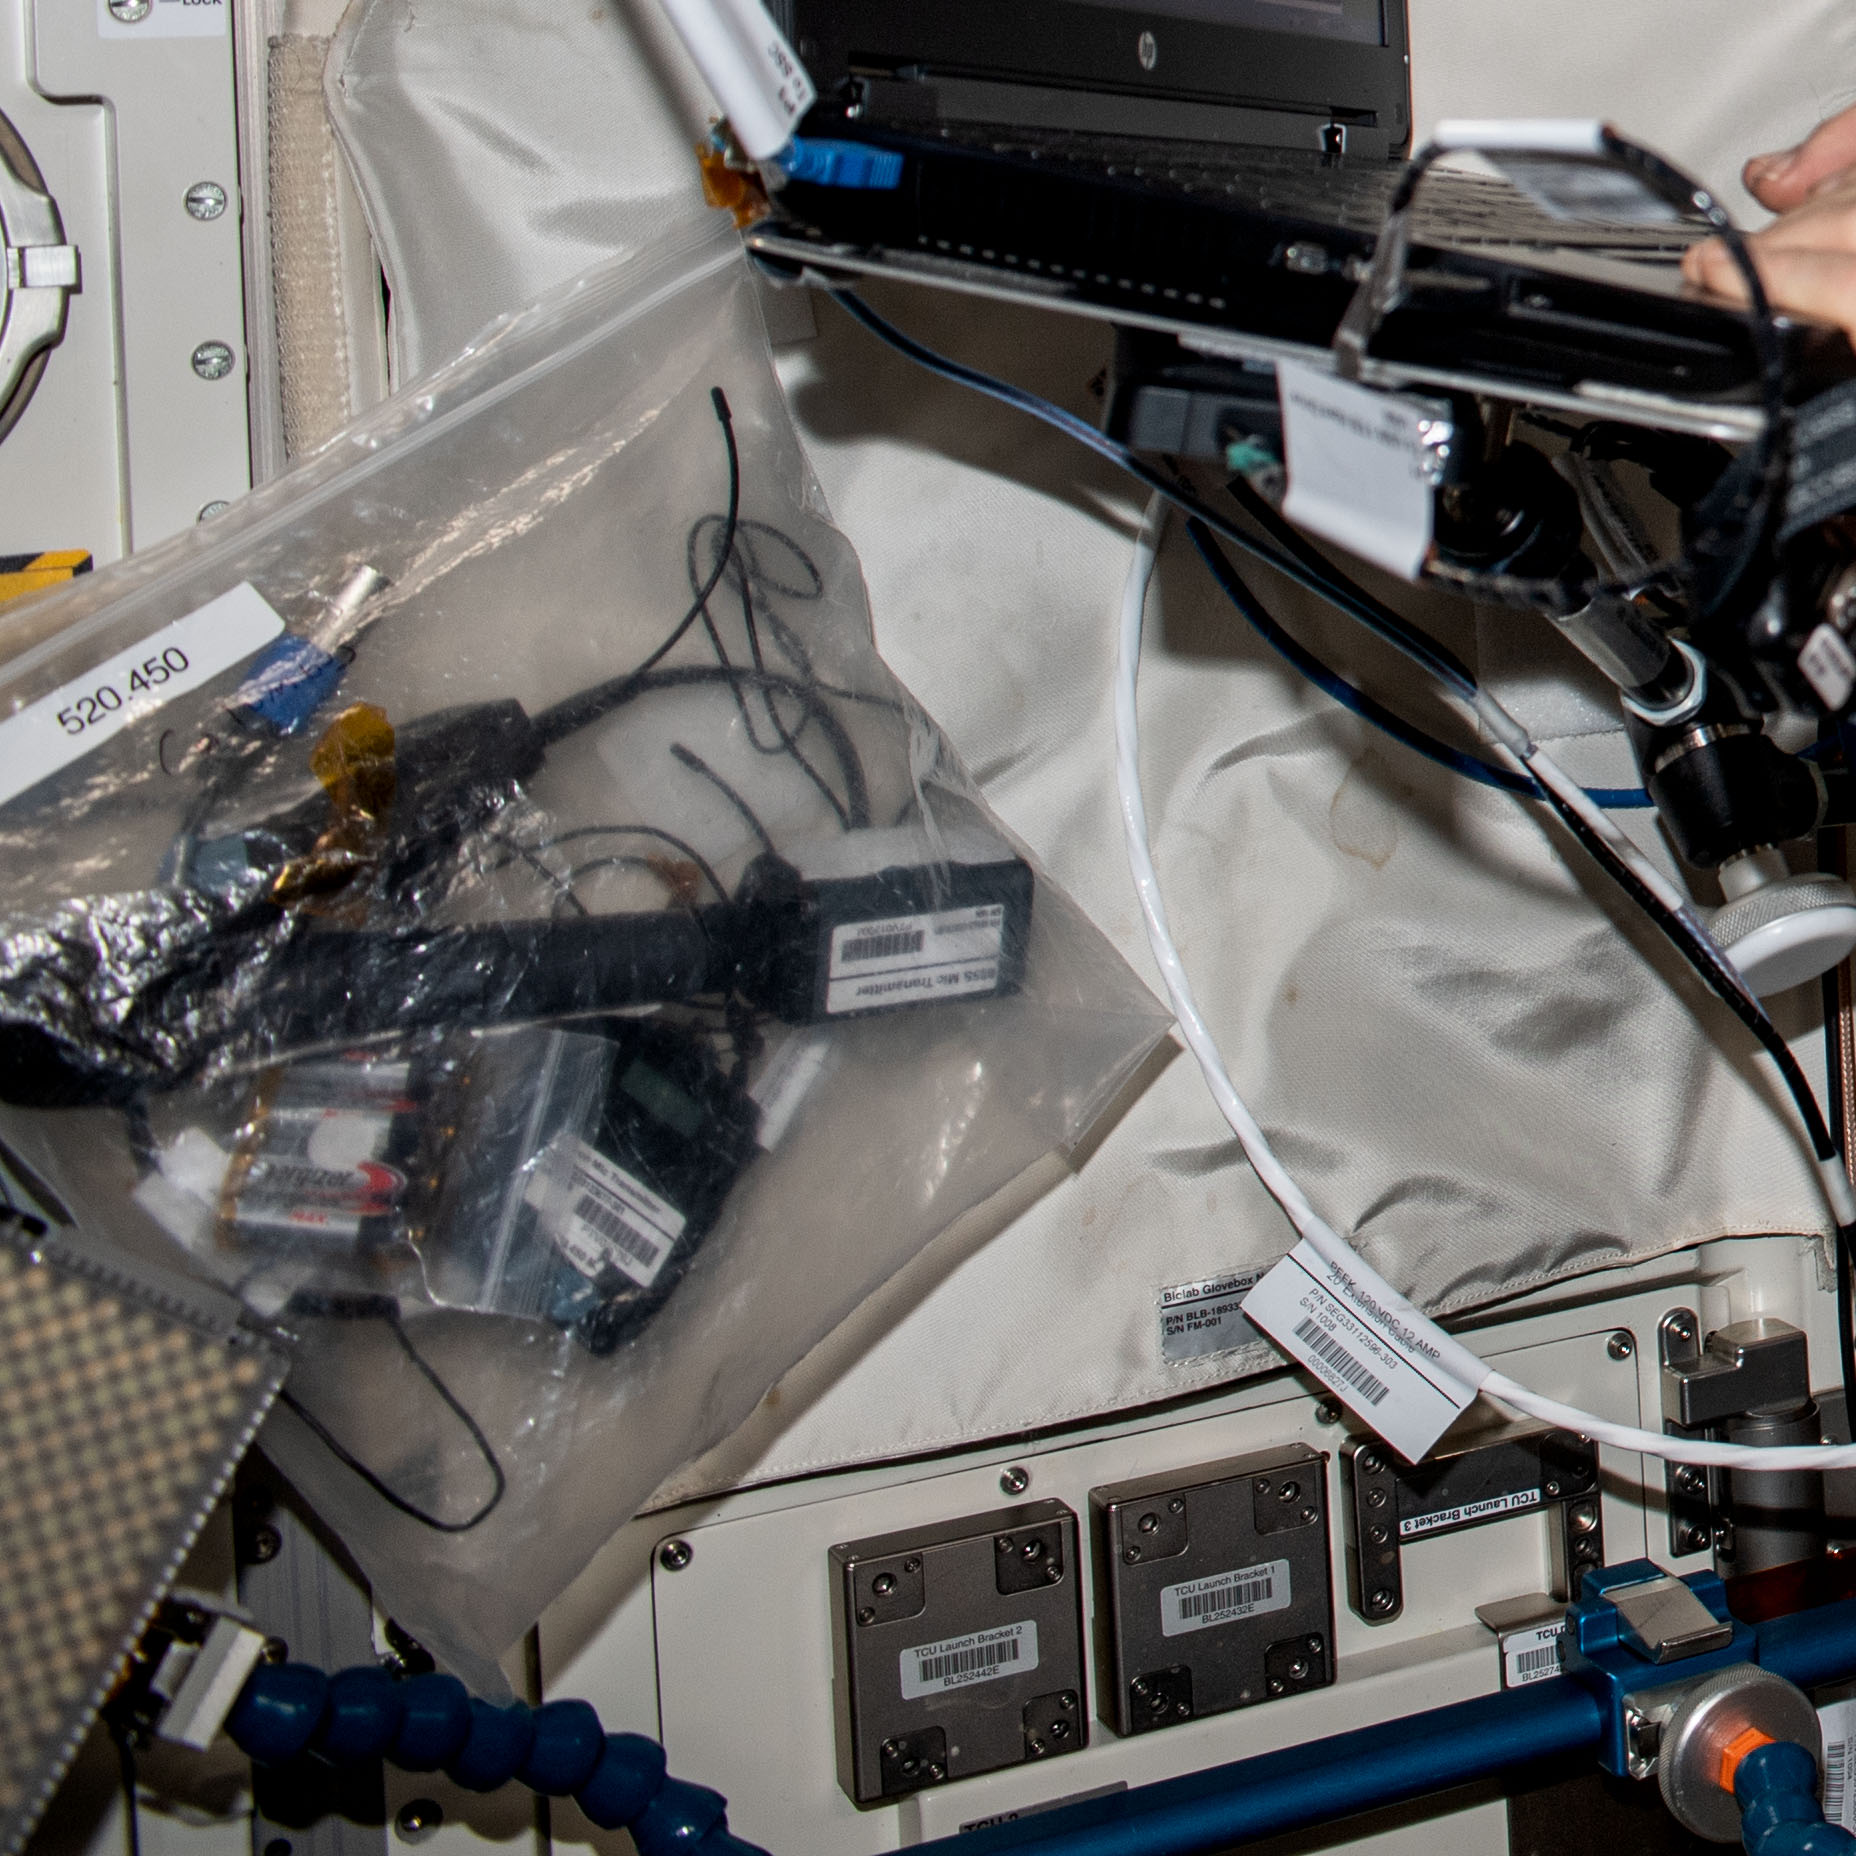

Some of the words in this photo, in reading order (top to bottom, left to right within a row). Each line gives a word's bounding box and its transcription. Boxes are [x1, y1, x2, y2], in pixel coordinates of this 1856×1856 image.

[56, 646, 190, 736] 520.450
[1163, 1287, 1200, 1303] Biolab
[1202, 1274, 1255, 1295] Glovebox
[1309, 1287, 1327, 1303] P/N
[1165, 1313, 1184, 1326] P/N
[1186, 1301, 1242, 1322] BLB-18933
[1299, 1297, 1315, 1313] S/N
[1316, 1309, 1338, 1333] 1008
[1166, 1324, 1185, 1336] S/N
[1187, 1316, 1223, 1332] FM-001
[1414, 1338, 1440, 1361] AMP
[1462, 1497, 1511, 1518] Launch
[1512, 1492, 1538, 1507] TCU
[1403, 1520, 1412, 1532] 3
[1418, 1509, 1462, 1528] Bracket
[1173, 1585, 1197, 1598] TCU
[1197, 1577, 1232, 1593] Launch
[1232, 1568, 1269, 1584] Bracket
[1201, 1603, 1256, 1624] BL252432E
[913, 1646, 938, 1659] TCU
[937, 1637, 976, 1655] Launch
[977, 1628, 1014, 1645] Bracket
[1016, 1625, 1024, 1637] 2
[1535, 1627, 1558, 1641] TCU
[943, 1664, 1002, 1687] BL252442E
[1521, 1662, 1561, 1682] BL25274
